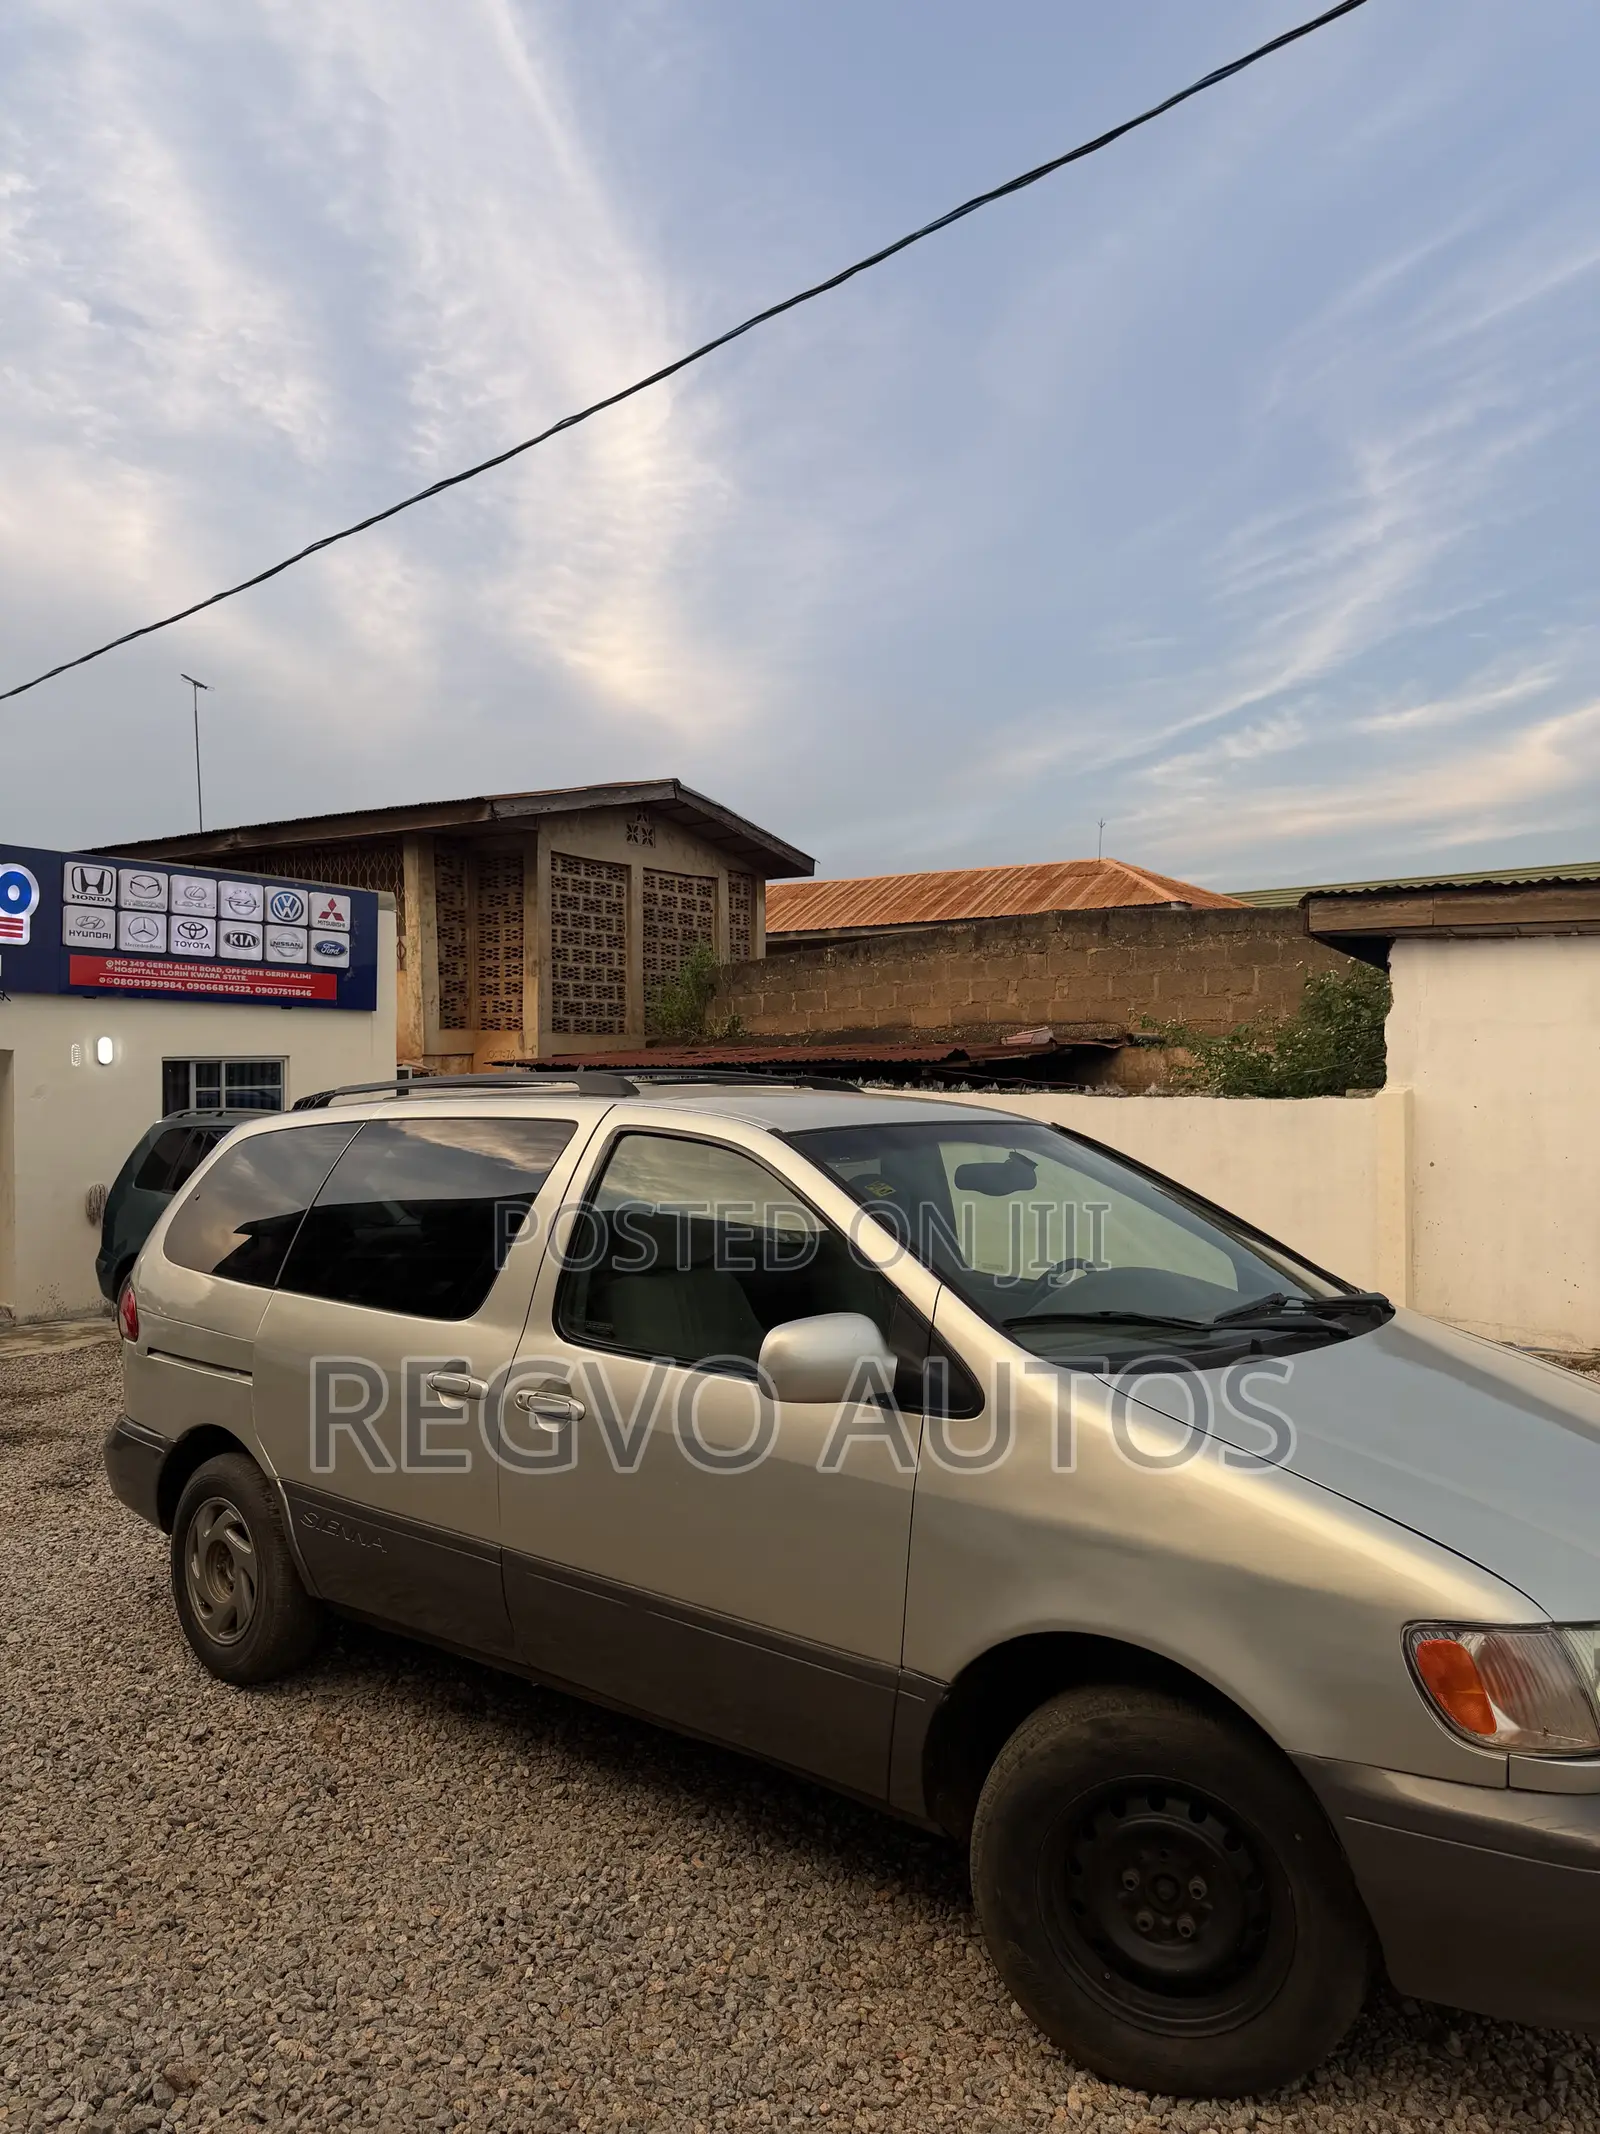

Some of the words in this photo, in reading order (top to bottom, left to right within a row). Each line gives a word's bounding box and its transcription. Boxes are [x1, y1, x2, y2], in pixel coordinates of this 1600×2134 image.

[71, 894, 112, 903] HONDA
[317, 920, 346, 928] MITSUBISHI
[68, 929, 112, 940] HYUNDAI
[229, 933, 254, 946] KIA
[174, 940, 211, 950] TOYOTA
[271, 940, 302, 948] NISSAN
[320, 942, 341, 955] Ford
[114, 966, 159, 976] HOSPITAL,
[190, 971, 220, 979] KWARA
[146, 961, 173, 970] GERIN
[199, 966, 224, 974] ROAD,
[290, 972, 312, 980] ALIMI
[113, 978, 185, 990] 08091999984,
[187, 983, 254, 993] 09066814222,
[255, 986, 312, 996] 09037511846
